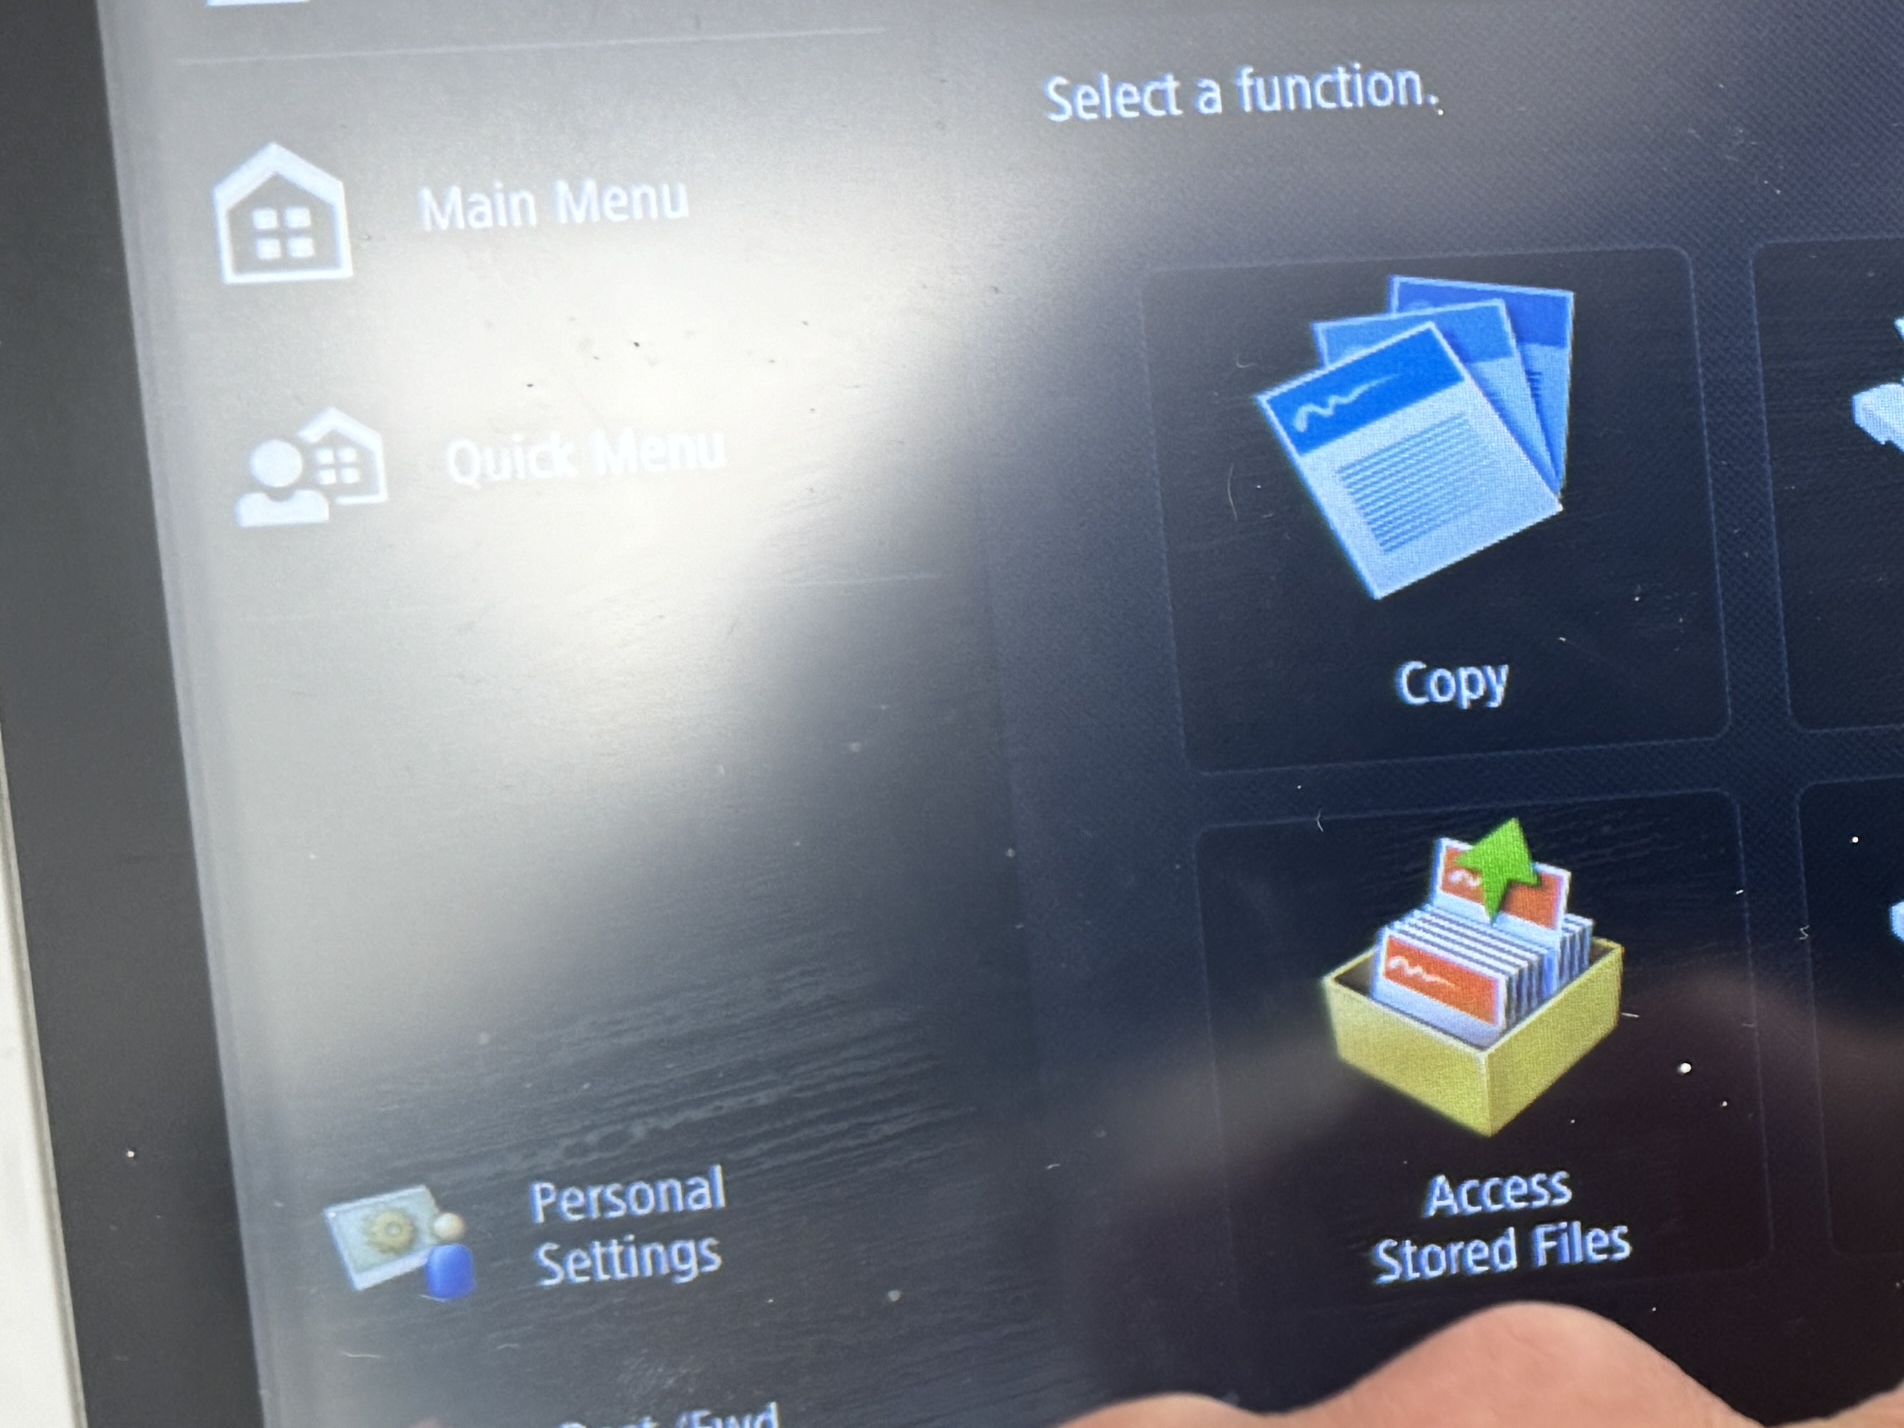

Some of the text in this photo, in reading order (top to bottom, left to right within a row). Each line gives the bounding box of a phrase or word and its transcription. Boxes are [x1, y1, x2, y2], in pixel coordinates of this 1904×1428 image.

[1044, 61, 1440, 122] Select a function.
[419, 178, 690, 232] Main Menu
[446, 428, 727, 489] Quick Menu
[1398, 658, 1509, 709] Copy
[530, 1165, 726, 1224] Personal
[1423, 1169, 1573, 1220] Access
[536, 1233, 722, 1287] Settings
[1375, 1220, 1632, 1286] Stored Files
